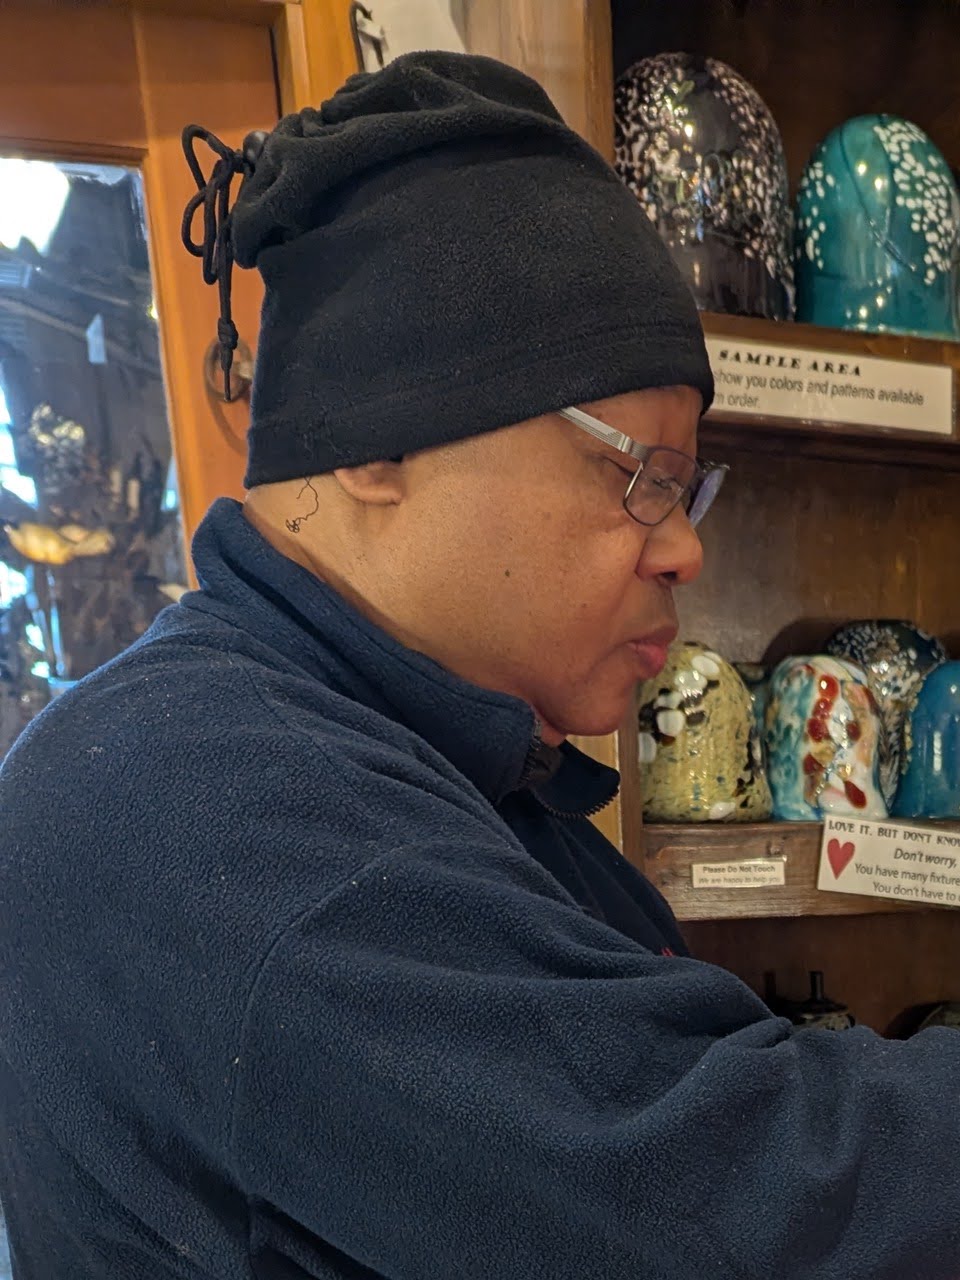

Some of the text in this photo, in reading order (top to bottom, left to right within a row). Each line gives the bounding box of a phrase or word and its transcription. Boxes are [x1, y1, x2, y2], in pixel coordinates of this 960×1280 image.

[719, 350, 861, 376] SAMPLE AREA
[746, 373, 767, 389] you
[769, 376, 803, 392] colors
[807, 379, 831, 394] and
[831, 382, 875, 400] patterns
[878, 387, 924, 406] available
[828, 820, 855, 833] LOVE
[877, 827, 898, 839] BUT
[893, 847, 924, 863] Don't
[925, 854, 957, 869] worry,
[855, 863, 873, 875] You
[874, 865, 899, 878] have
[901, 870, 928, 884] many
[930, 872, 960, 887] fixture
[873, 882, 891, 894] You
[894, 884, 919, 897] don't
[921, 888, 943, 900] have
[946, 892, 956, 901] to
